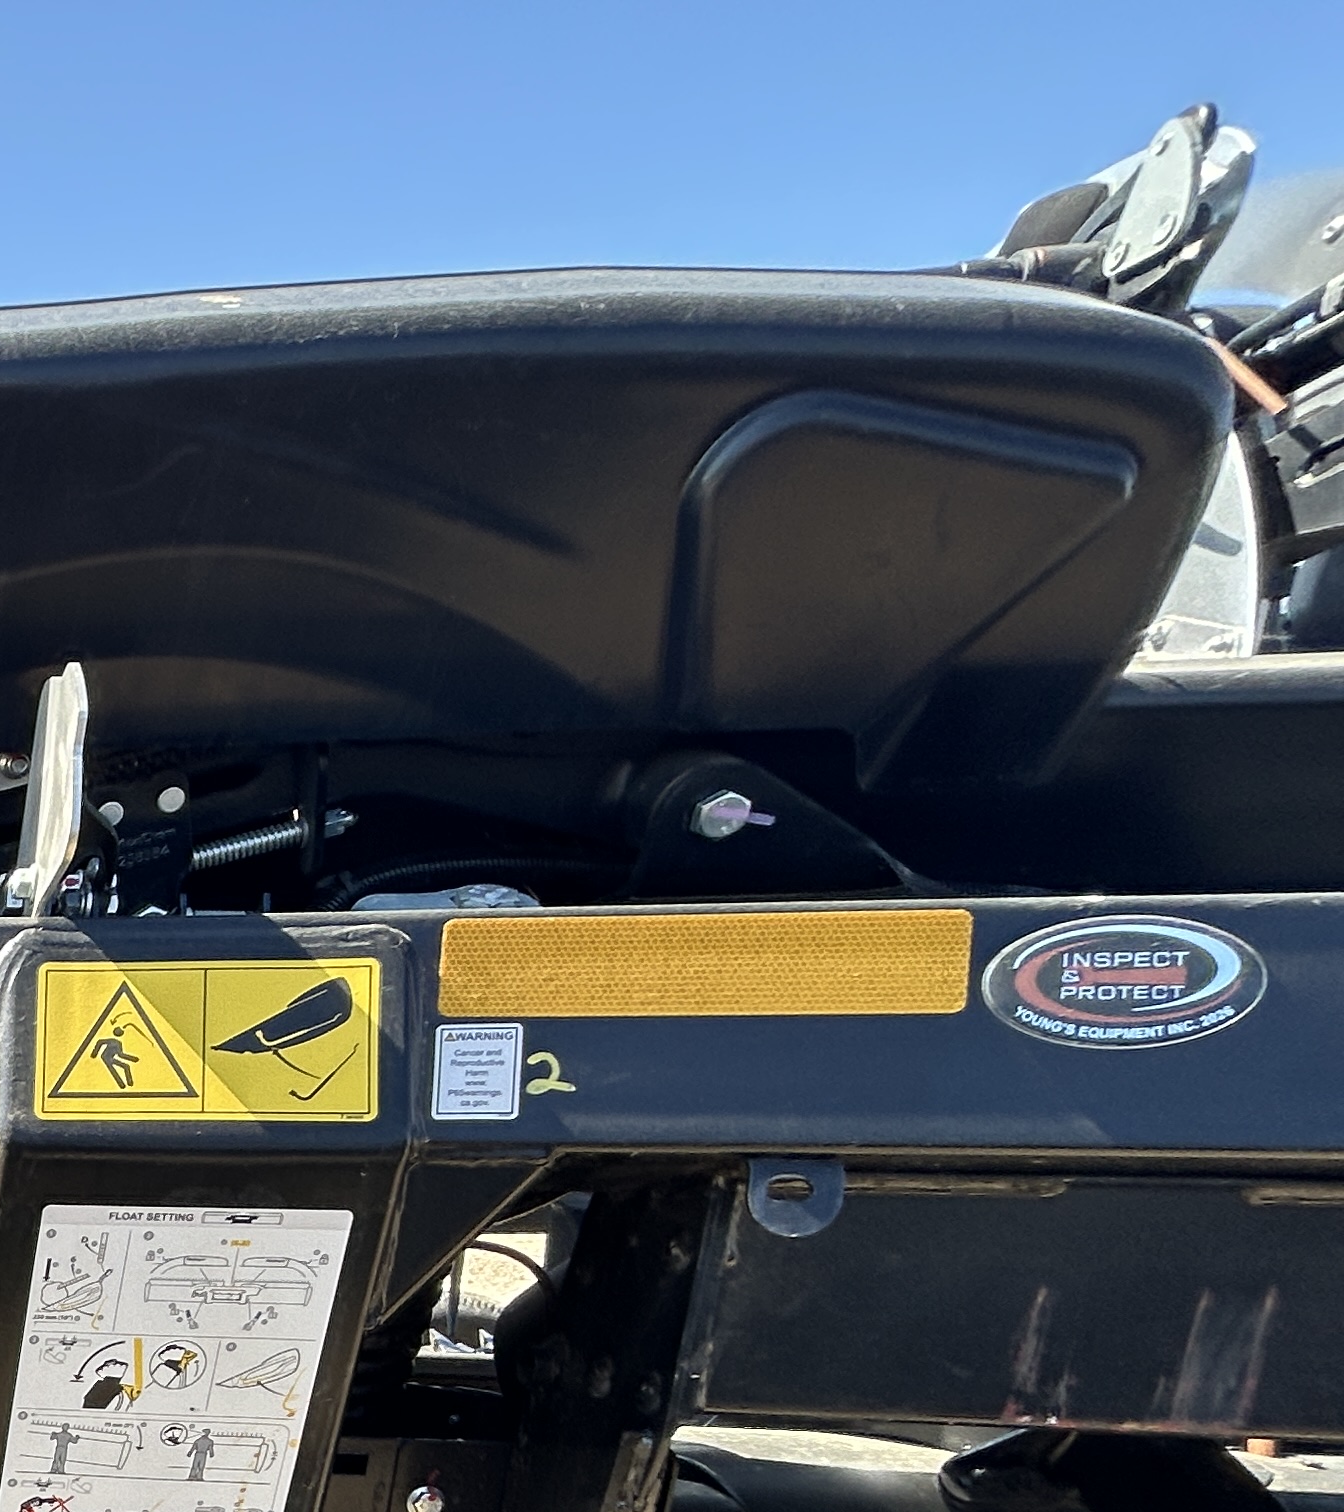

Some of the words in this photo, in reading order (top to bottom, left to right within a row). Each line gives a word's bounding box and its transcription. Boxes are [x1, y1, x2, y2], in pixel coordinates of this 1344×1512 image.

[1061, 950, 1190, 968] INSPECT
[1061, 969, 1081, 983] &
[1059, 984, 1186, 1001] PROTECT
[1013, 1005, 1076, 1035] YOUNG'S
[1078, 1024, 1165, 1039] EQUIPMENT
[455, 1030, 514, 1041] WARNING
[525, 1051, 577, 1096] 2
[108, 1211, 144, 1221] FLOAT
[145, 1212, 195, 1222] SETTING
